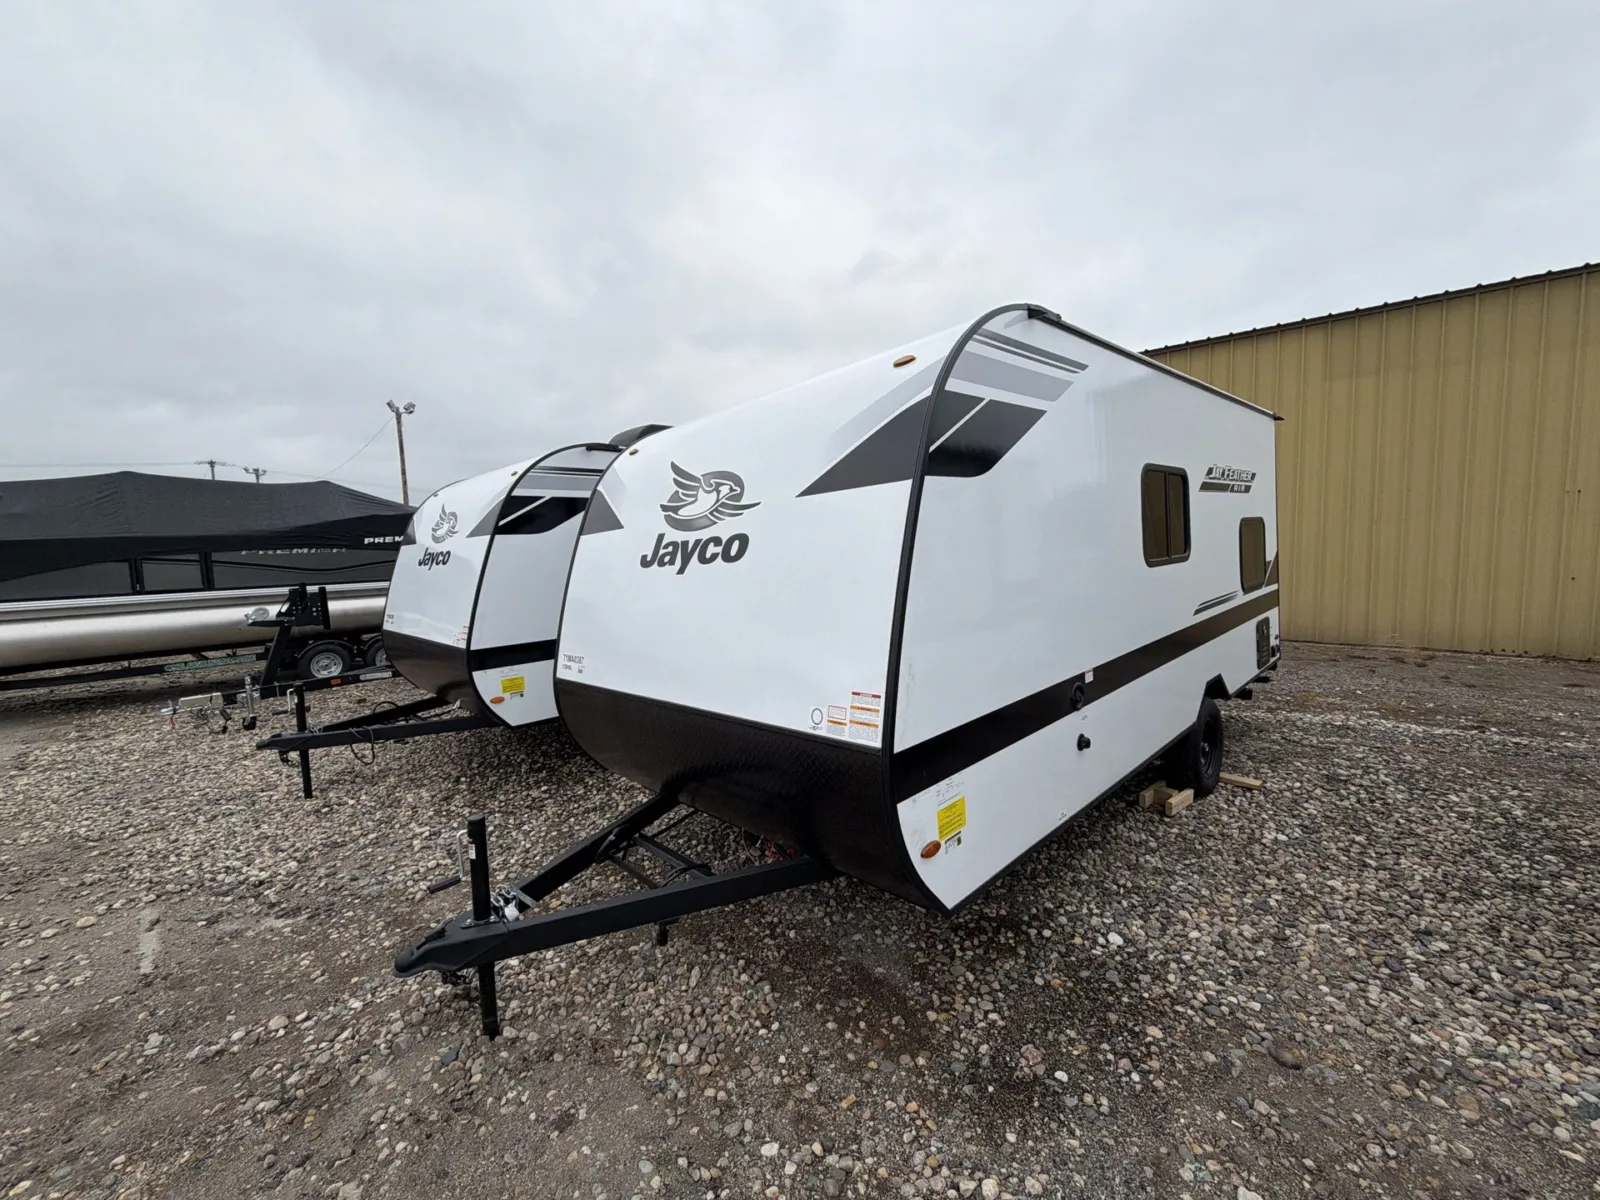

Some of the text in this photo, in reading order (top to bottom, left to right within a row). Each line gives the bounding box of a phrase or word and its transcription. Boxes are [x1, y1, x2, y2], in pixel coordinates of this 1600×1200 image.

[1209, 464, 1253, 481] JAY FEATHER
[417, 547, 452, 571] Jayco
[640, 533, 750, 575] Jayco
